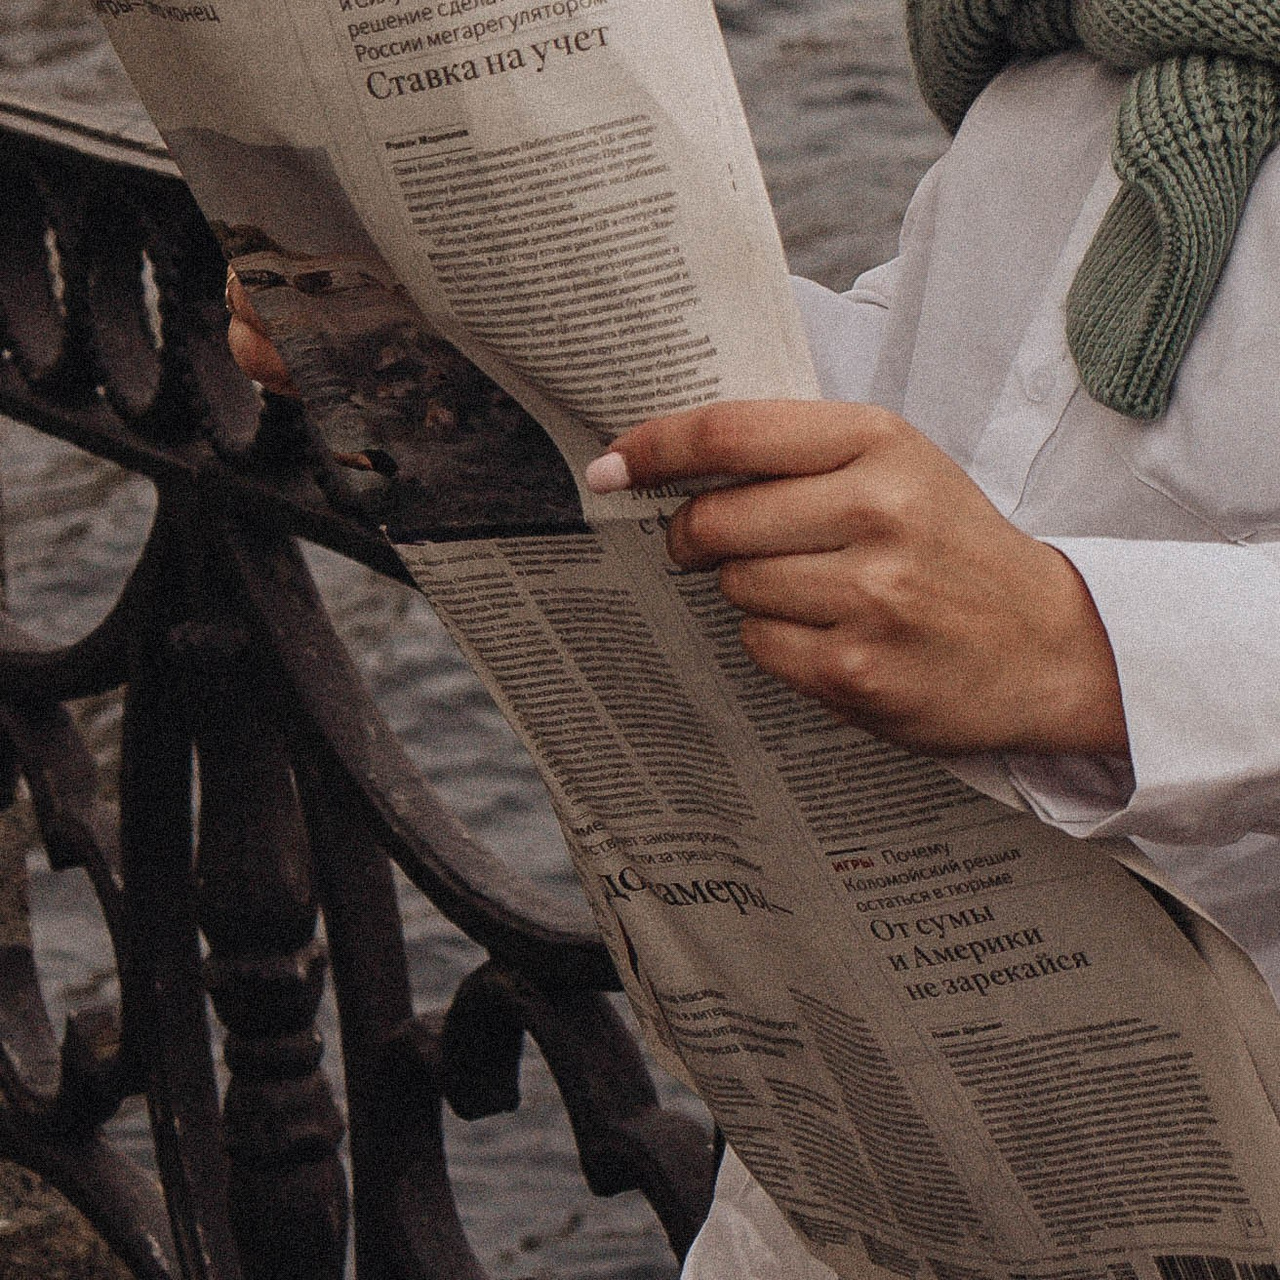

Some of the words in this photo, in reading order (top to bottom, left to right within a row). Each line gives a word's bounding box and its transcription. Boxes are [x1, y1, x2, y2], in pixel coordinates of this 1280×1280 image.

[347, 6, 433, 41] решение
[354, 34, 423, 62] России
[366, 58, 479, 101] Ставка
[485, 46, 526, 77] на
[531, 25, 609, 73] учет
[843, 860, 961, 894] Коломойский
[962, 846, 1022, 875] решил
[882, 841, 951, 866] Почему
[855, 885, 932, 914] остаться
[933, 887, 944, 900] в
[946, 871, 1014, 900] тюрьме
[870, 917, 911, 942] От
[915, 903, 997, 940] сумы
[888, 953, 910, 973] и
[912, 926, 1045, 969] Америки
[905, 978, 943, 1002] не
[946, 948, 1093, 998] зарекайся
